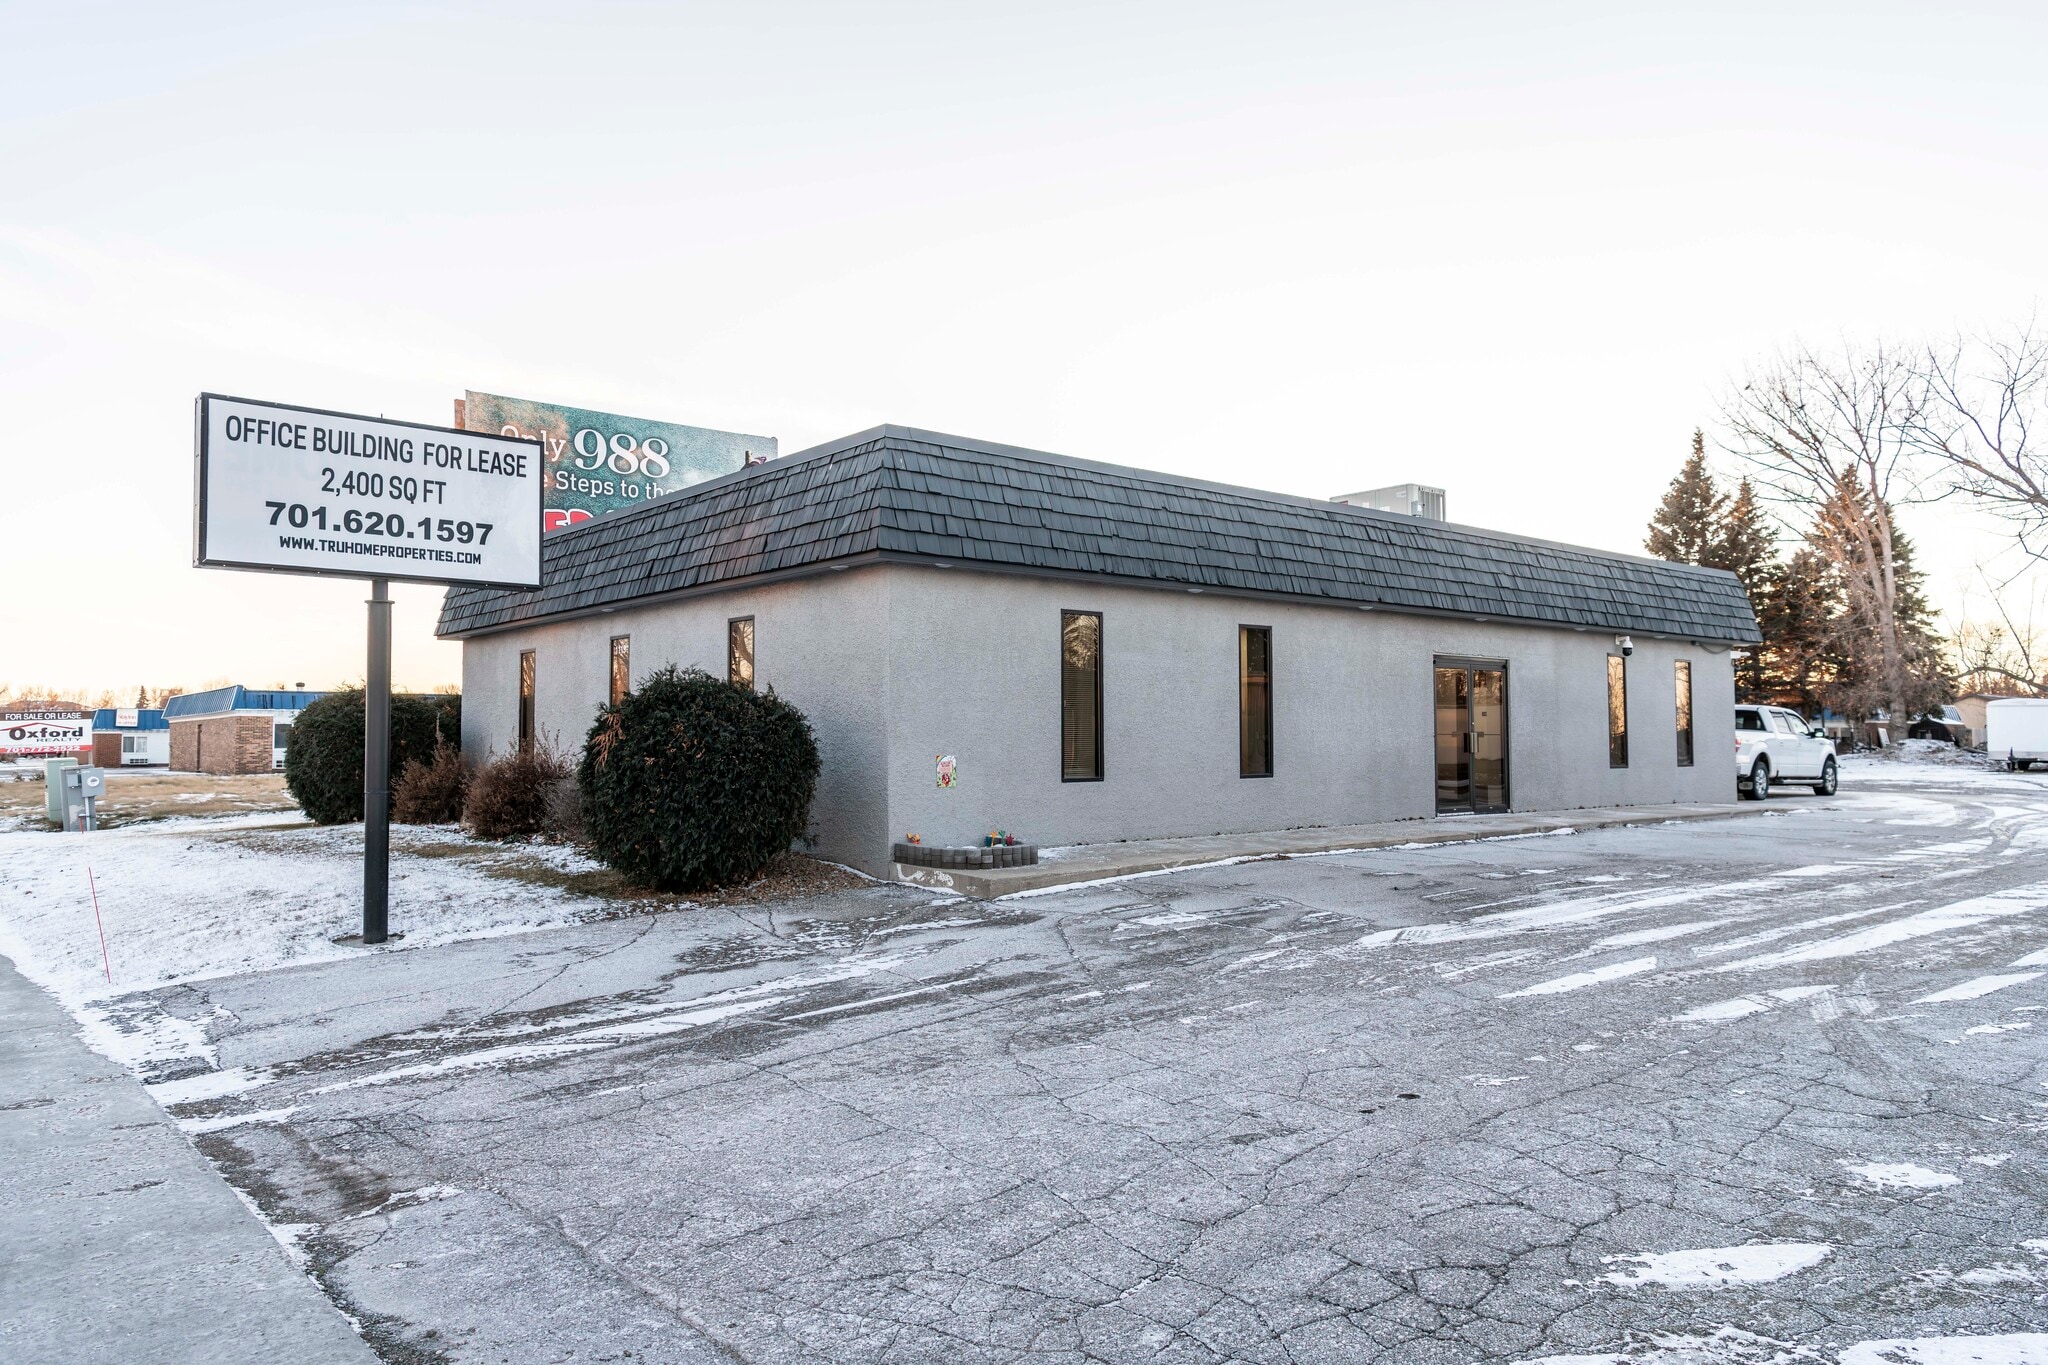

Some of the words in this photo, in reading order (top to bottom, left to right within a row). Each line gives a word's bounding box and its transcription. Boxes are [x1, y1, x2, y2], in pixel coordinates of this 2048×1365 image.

[226, 415, 307, 450] OFFICE
[313, 427, 413, 463] BUILDING
[423, 442, 462, 470] FOR
[467, 448, 527, 478] LEASE
[574, 428, 670, 478] 988
[321, 467, 383, 497] 2,400
[389, 475, 417, 504] SQ
[423, 479, 446, 505] FT
[556, 471, 614, 497] Steps
[620, 476, 639, 498] to
[645, 482, 675, 499] th
[265, 501, 493, 545] 701.620.1597
[279, 535, 482, 564] WWW.TRUHOMEPROPERTIES.COM
[9, 727, 84, 741] Oxford
